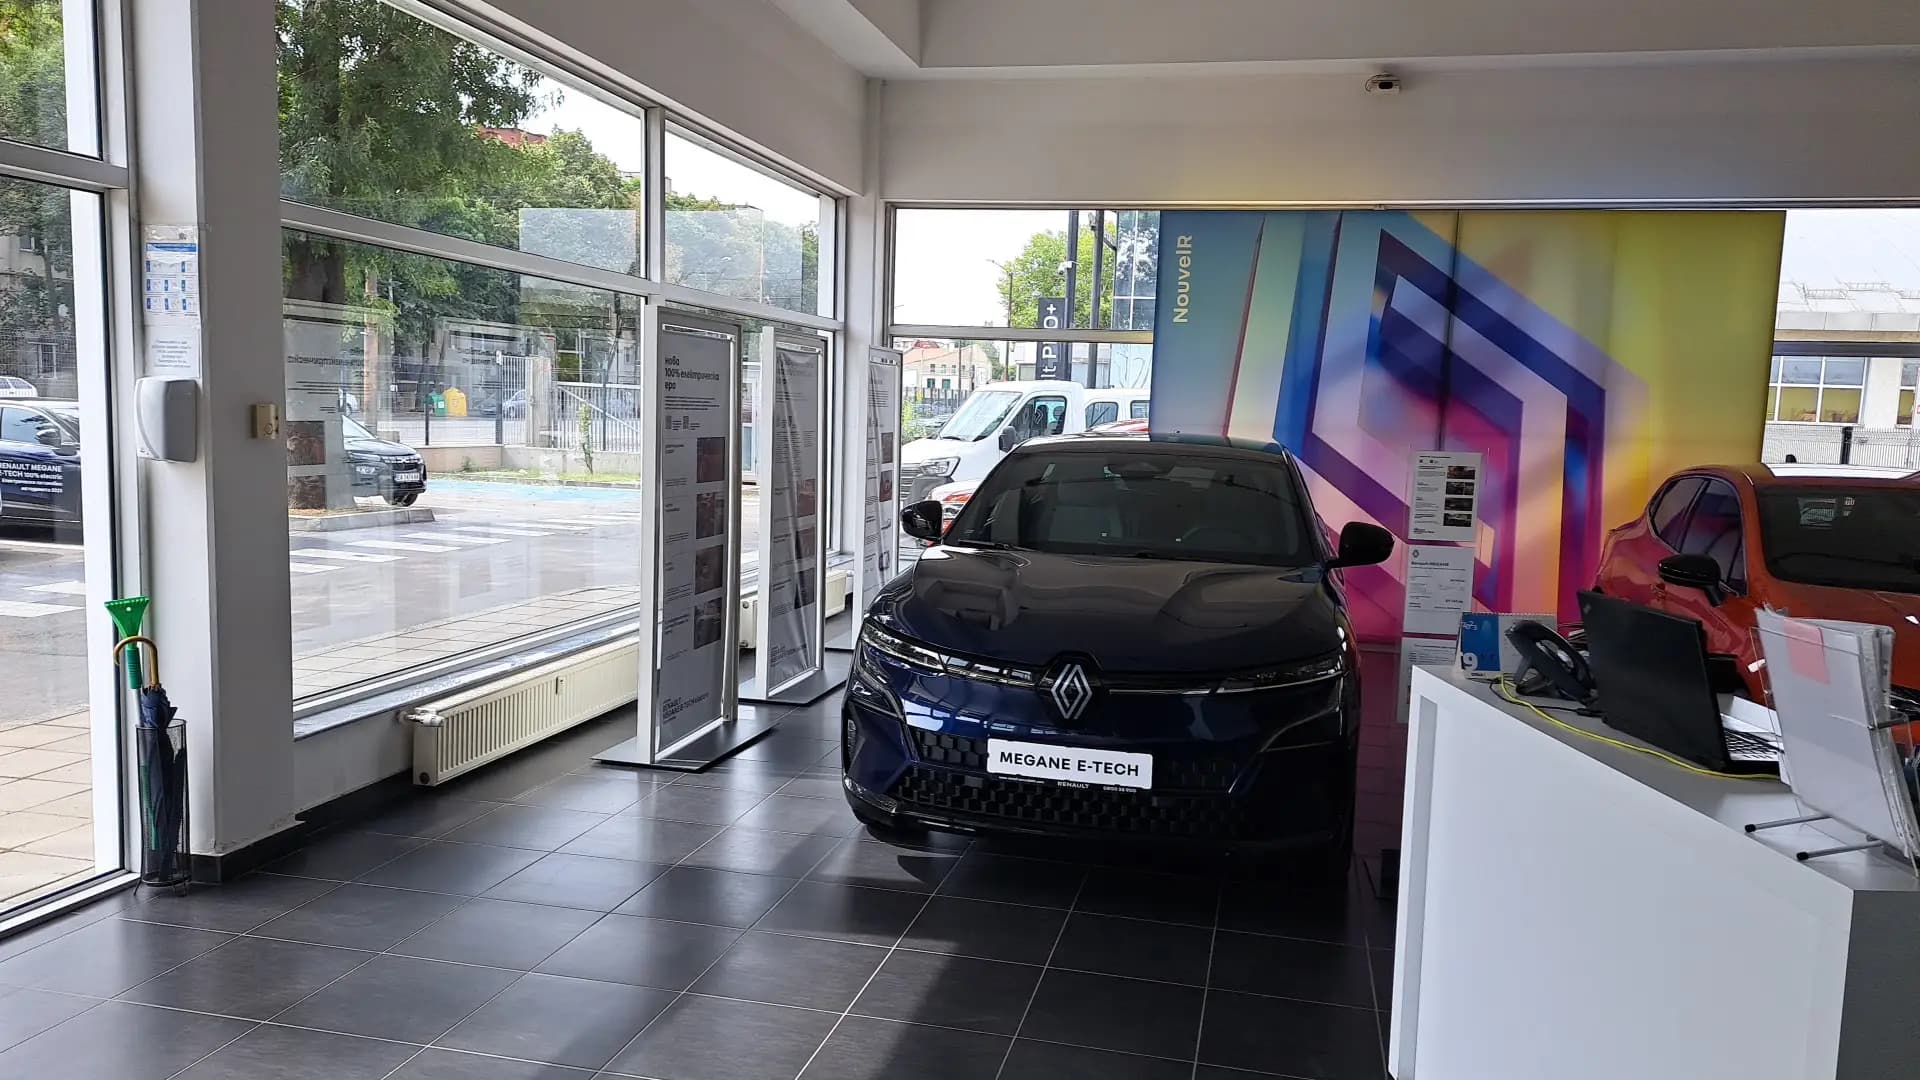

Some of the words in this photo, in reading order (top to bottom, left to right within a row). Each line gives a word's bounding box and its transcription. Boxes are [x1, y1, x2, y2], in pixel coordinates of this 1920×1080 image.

[1173, 235, 1192, 323] NouvelR
[1042, 303, 1059, 359] PO+
[31, 464, 63, 473] MEGANE
[999, 752, 1071, 770] MEGANE
[1077, 760, 1139, 777] E-TECH
[1057, 781, 1089, 789] RENAULT
